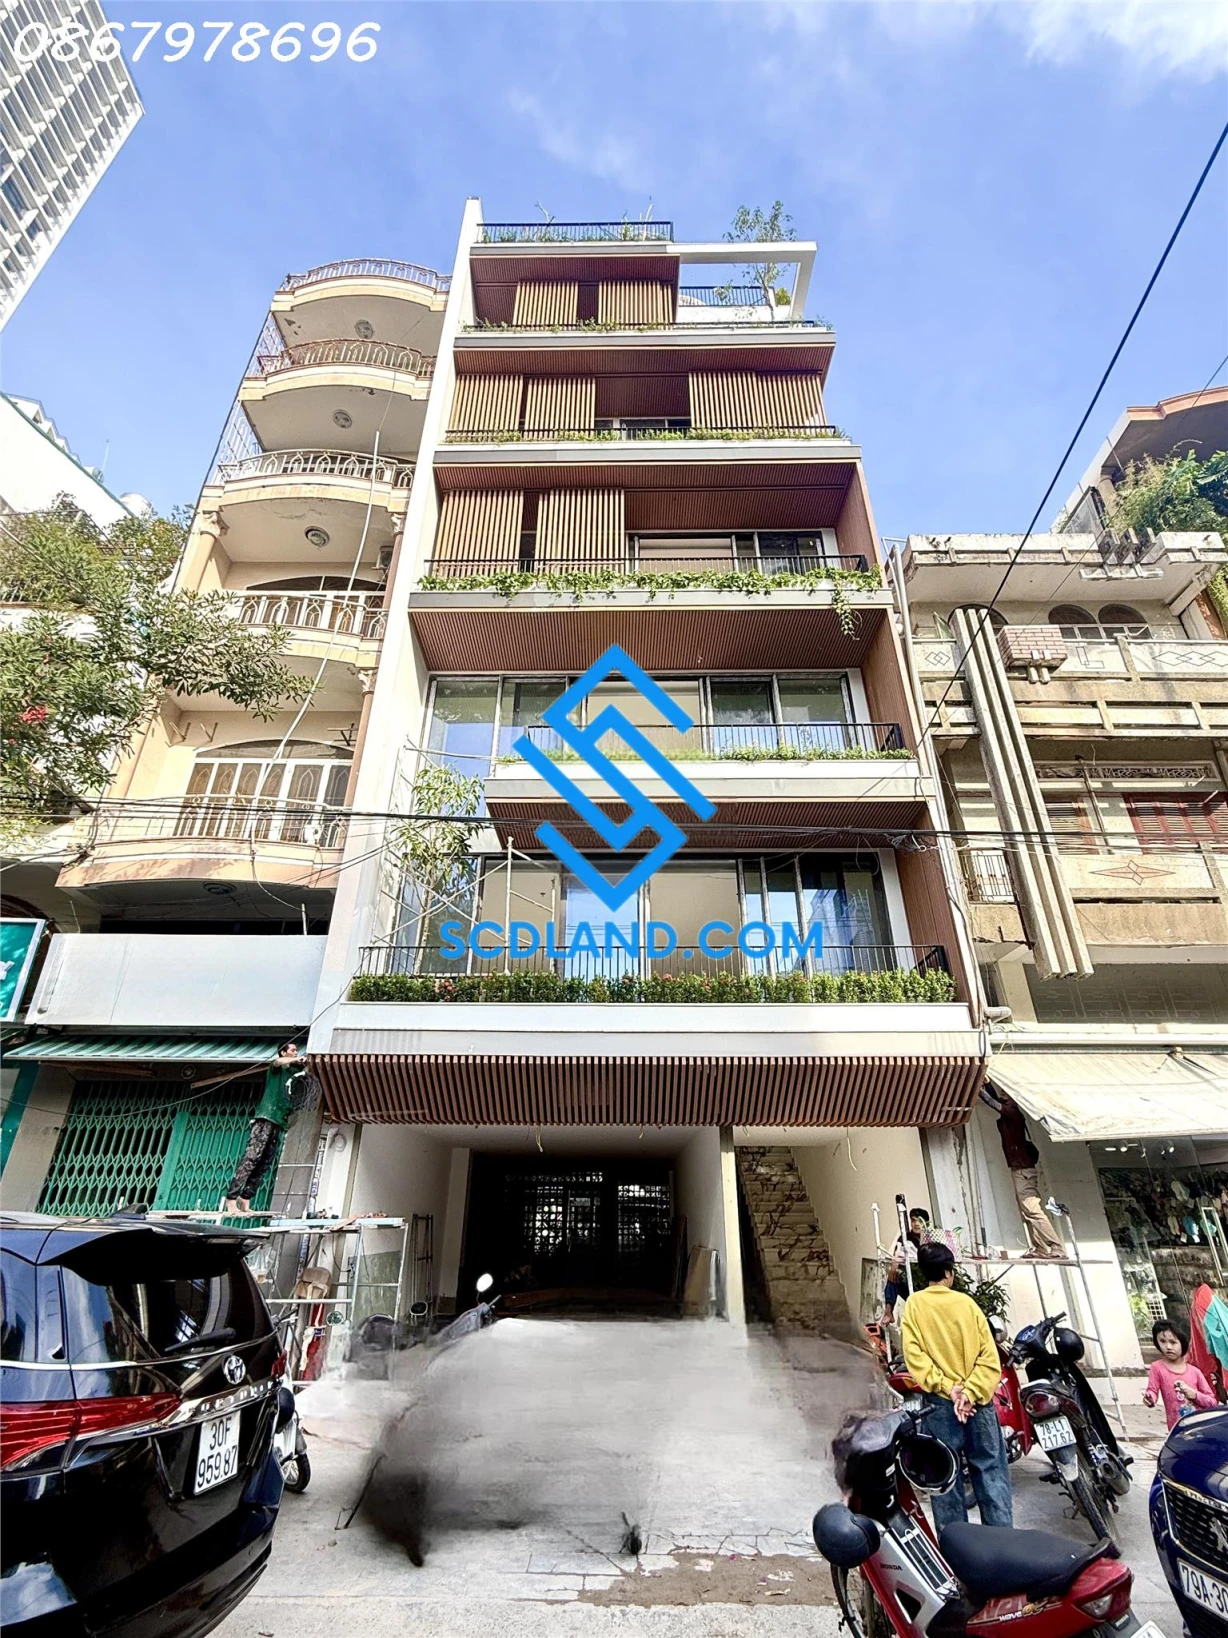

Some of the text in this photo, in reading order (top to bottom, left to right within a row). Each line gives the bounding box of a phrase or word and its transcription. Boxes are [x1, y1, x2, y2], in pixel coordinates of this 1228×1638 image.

[209, 1416, 232, 1451] 30F
[1040, 1420, 1064, 1436] 78-L1
[196, 1444, 238, 1488] 959.87
